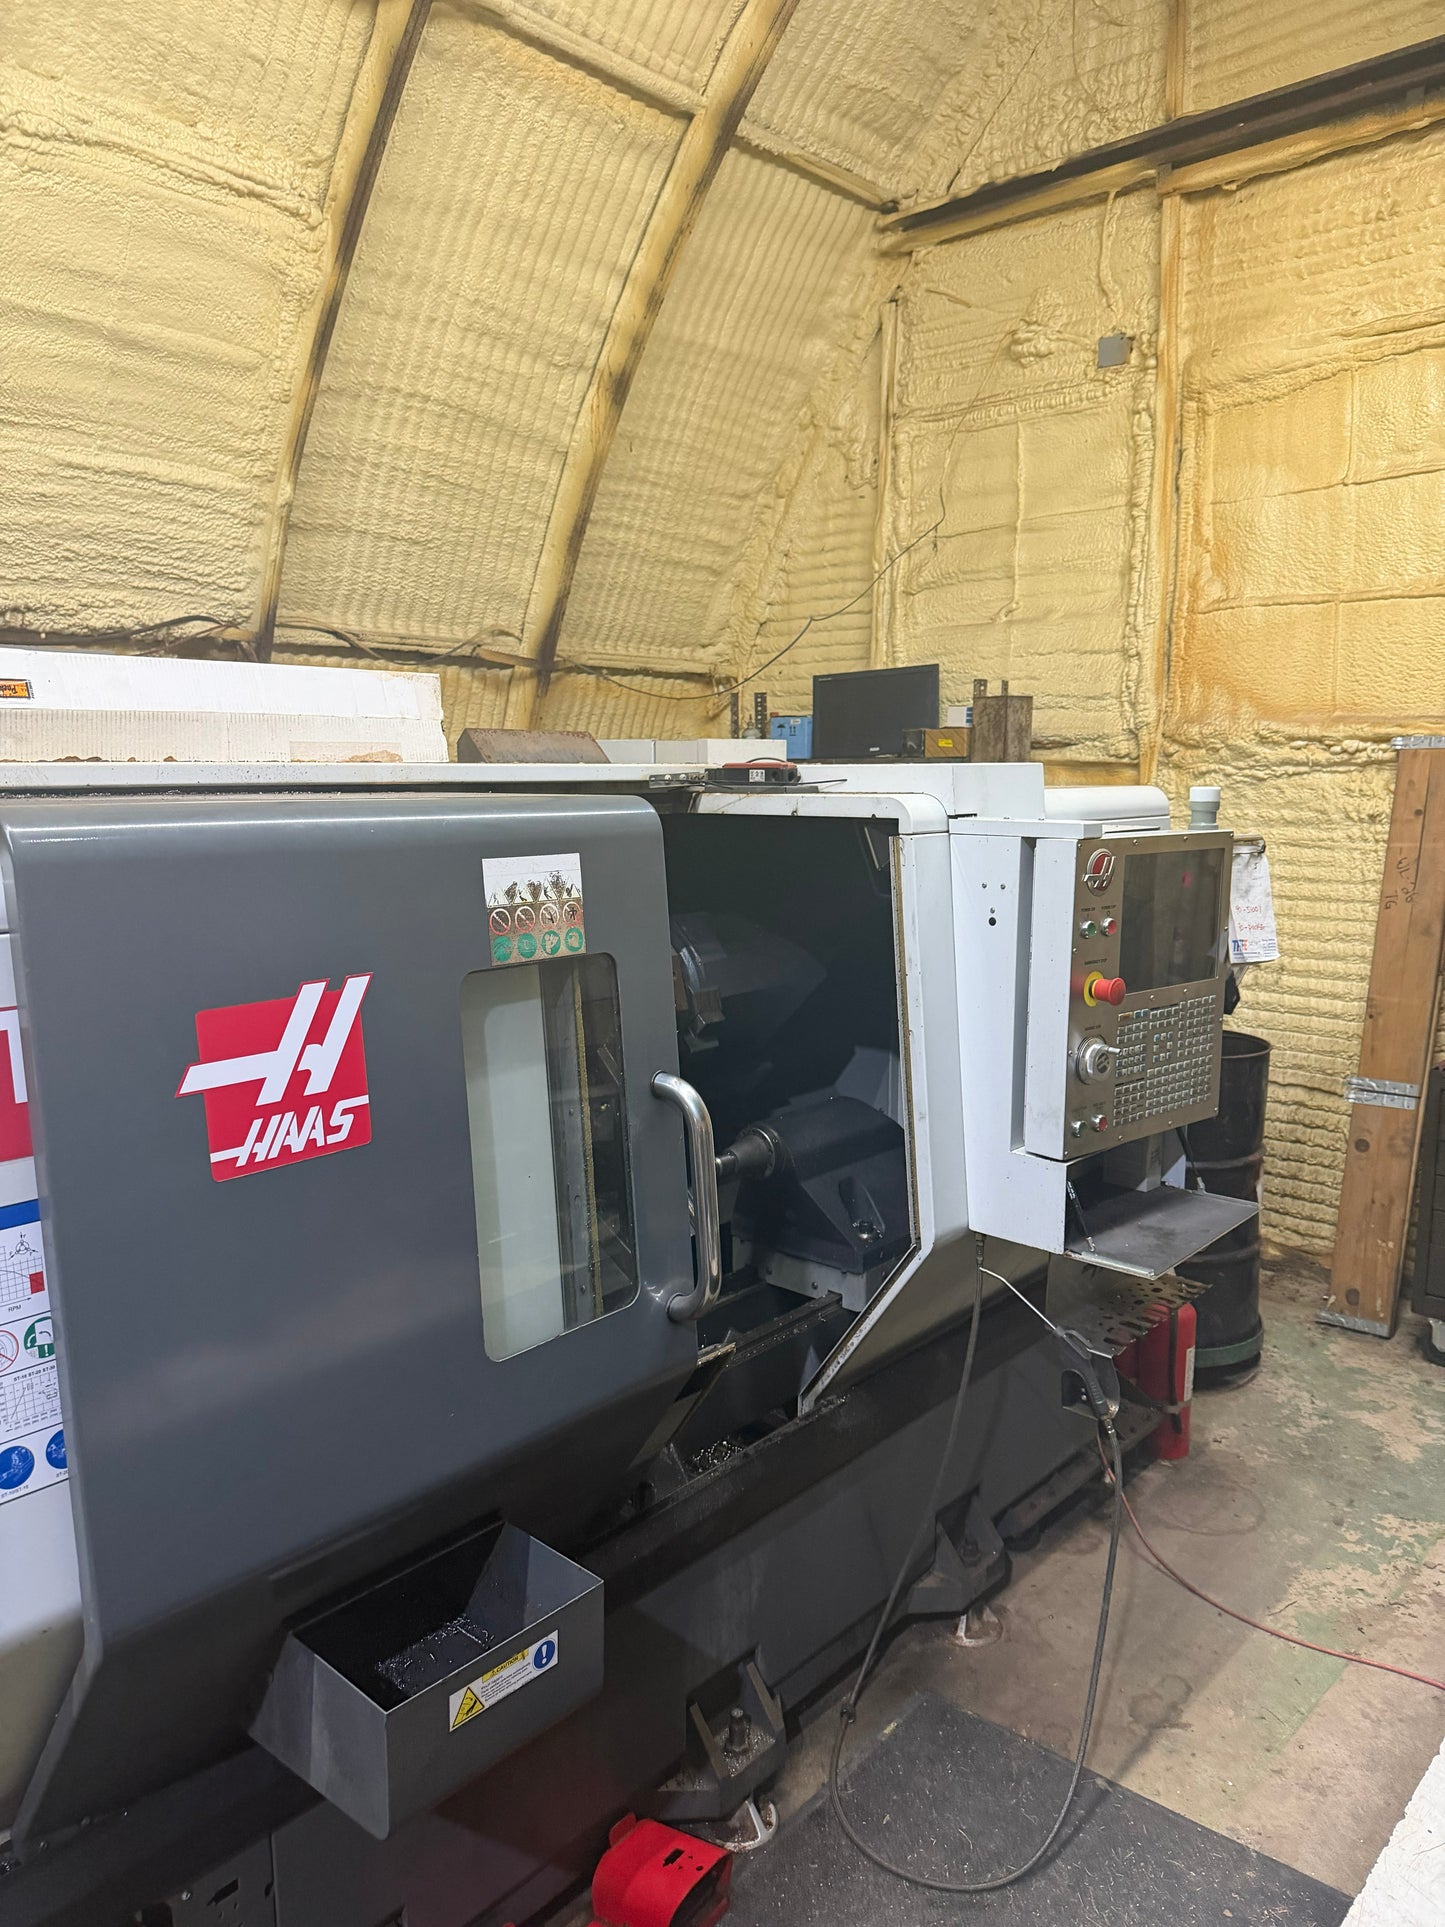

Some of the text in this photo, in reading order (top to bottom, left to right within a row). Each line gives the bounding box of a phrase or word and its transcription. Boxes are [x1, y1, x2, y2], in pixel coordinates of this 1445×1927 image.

[210, 1094, 370, 1168] HAAS
[8, 1304, 22, 1313] RPM
[496, 1655, 519, 1673] CAUTION
